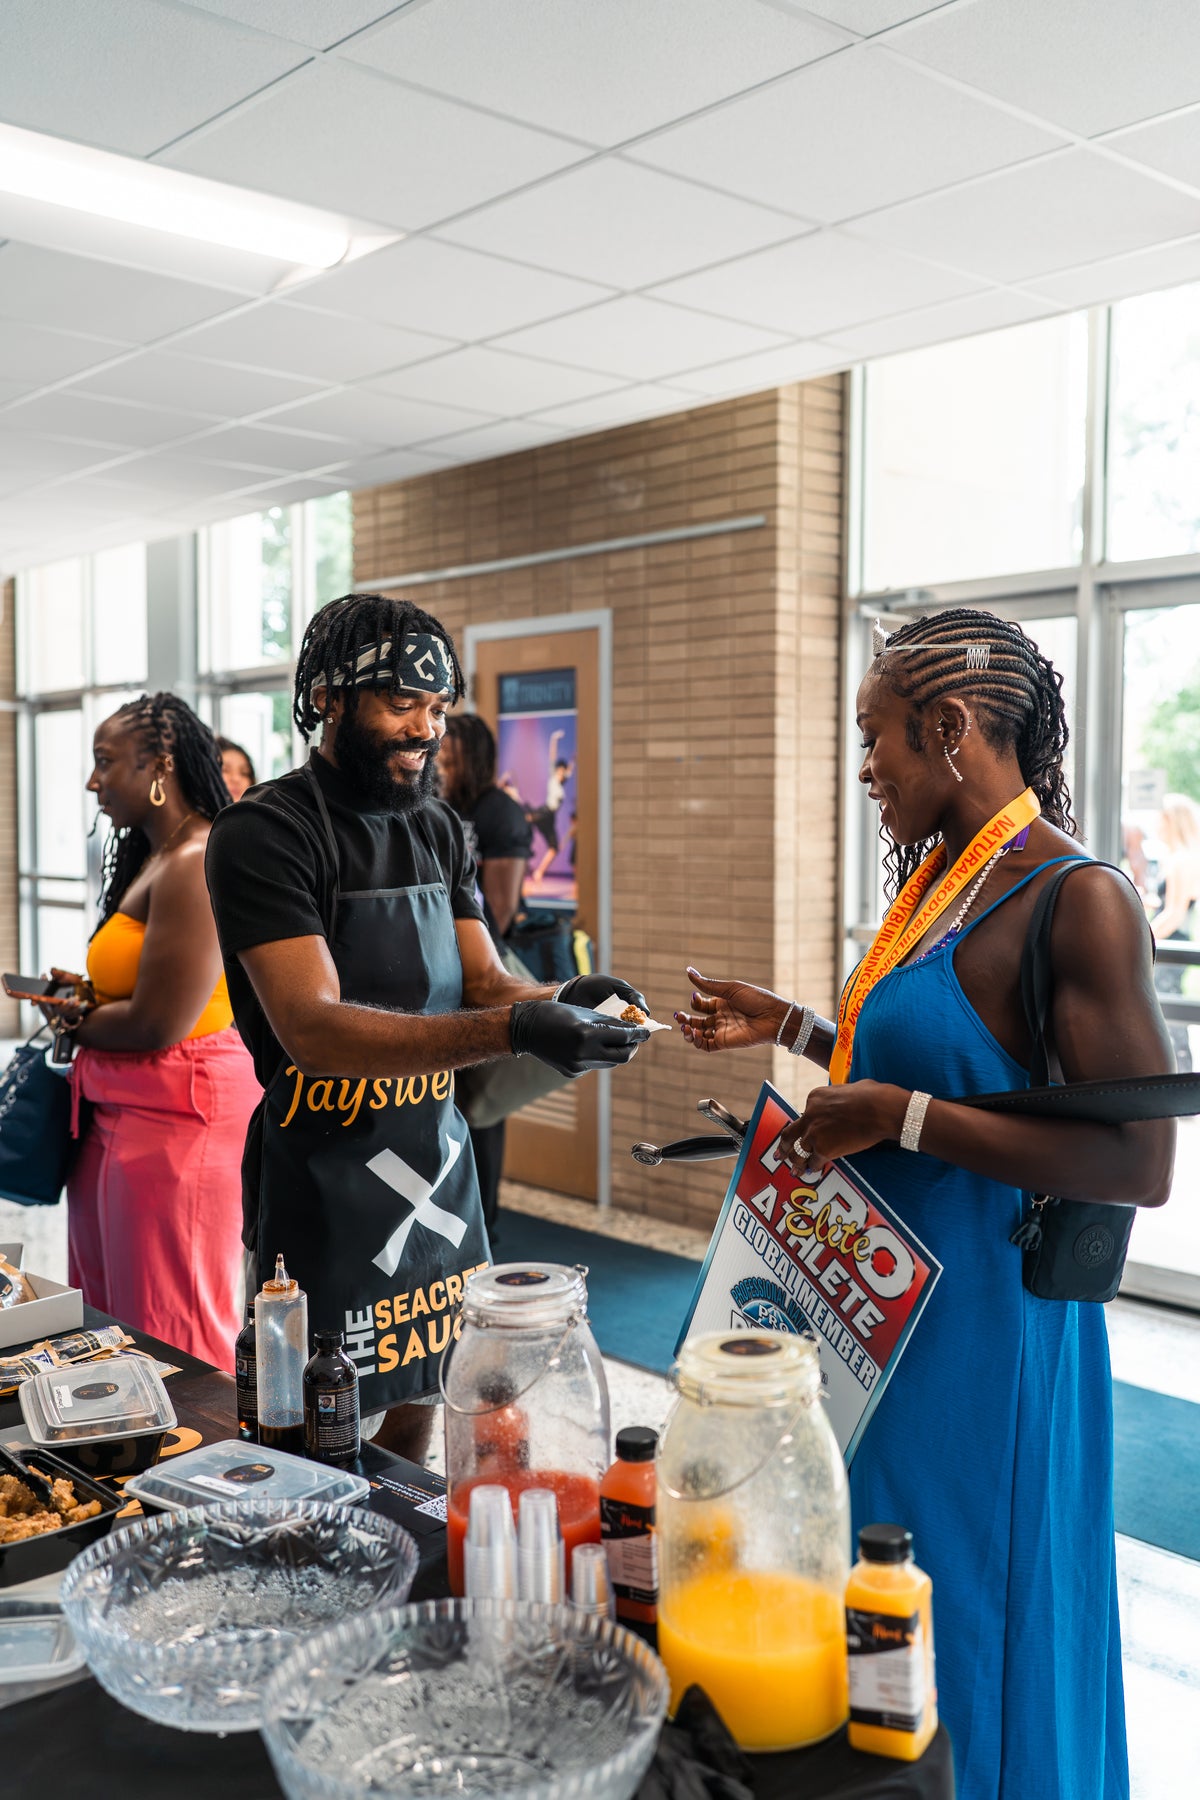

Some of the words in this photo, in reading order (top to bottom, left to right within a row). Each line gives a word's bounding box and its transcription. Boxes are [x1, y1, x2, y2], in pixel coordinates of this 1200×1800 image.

[750, 1183, 886, 1340] ATHLETE
[785, 1187, 871, 1262] Elite
[730, 1277, 788, 1309] PROFESSIONAL
[733, 1204, 799, 1296] GLOBAL
[795, 1279, 878, 1391] MEMBER
